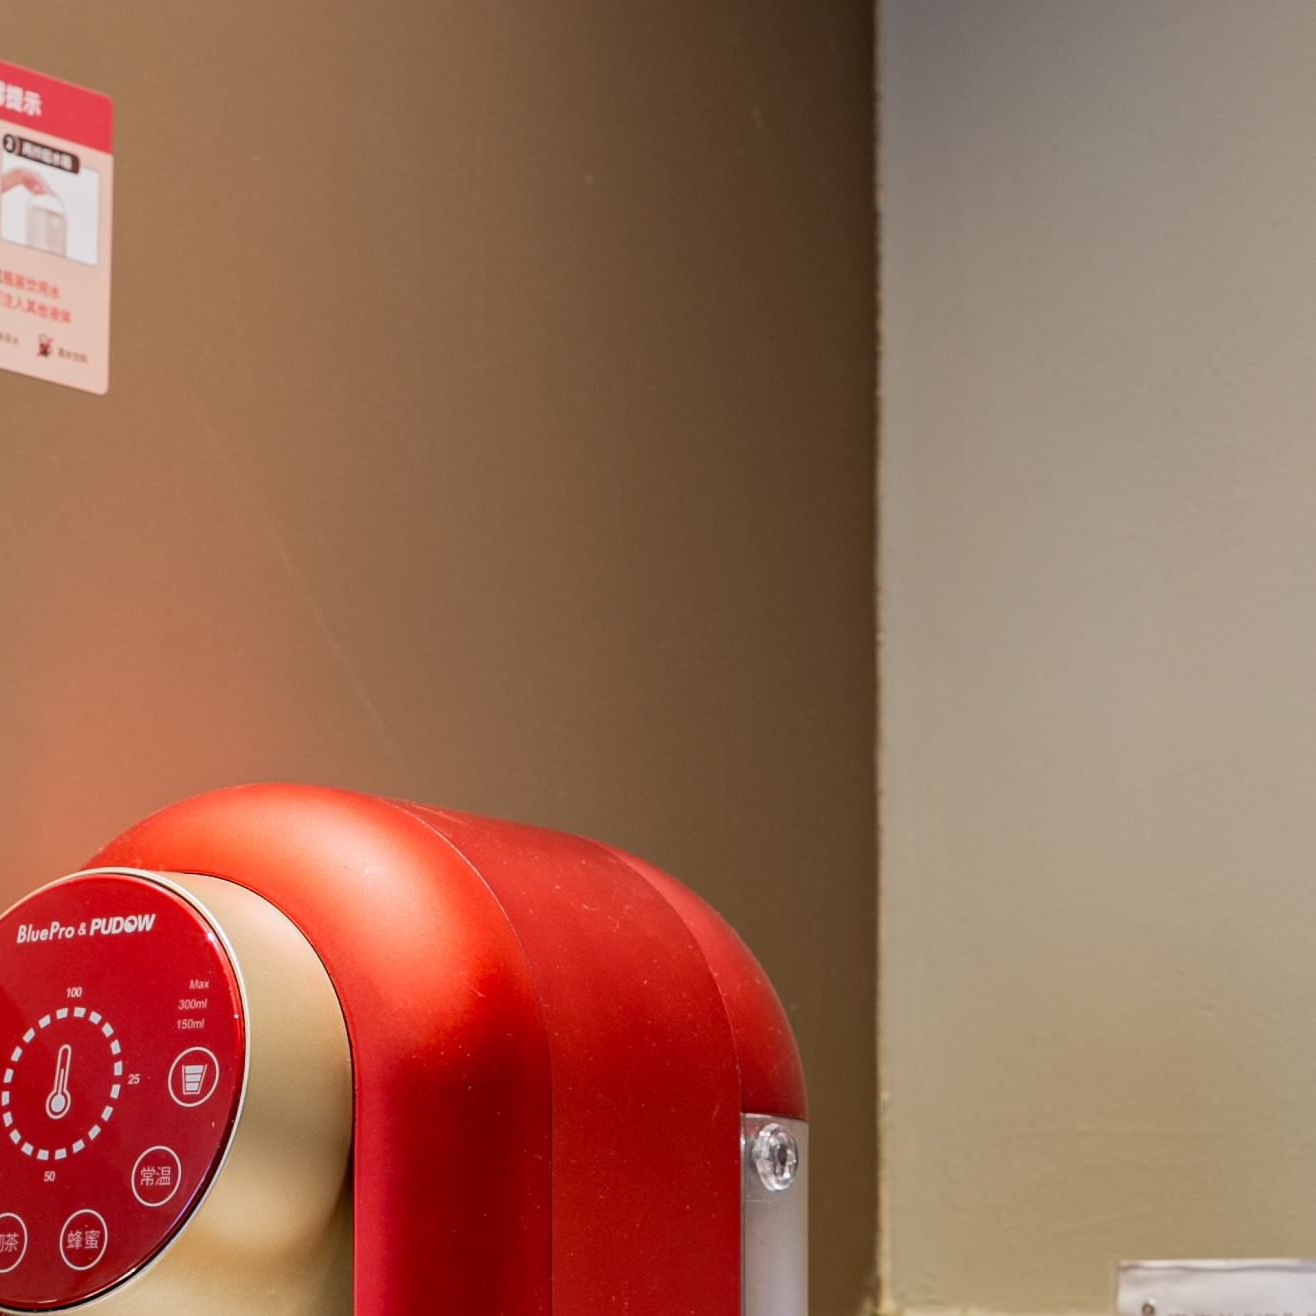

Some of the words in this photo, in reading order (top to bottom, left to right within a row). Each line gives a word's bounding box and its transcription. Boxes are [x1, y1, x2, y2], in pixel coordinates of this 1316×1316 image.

[16, 921, 75, 944] BluePro
[77, 922, 87, 936] &
[89, 914, 156, 936] PUDOW
[189, 979, 210, 990] Max
[66, 986, 83, 999] 100
[178, 999, 208, 1011] 300ml
[176, 1018, 205, 1030] 150ml
[128, 1073, 141, 1086] 25
[43, 1171, 56, 1183] 50
[140, 1165, 172, 1187] 常温
[66, 1230, 100, 1251] 蜂蜜
